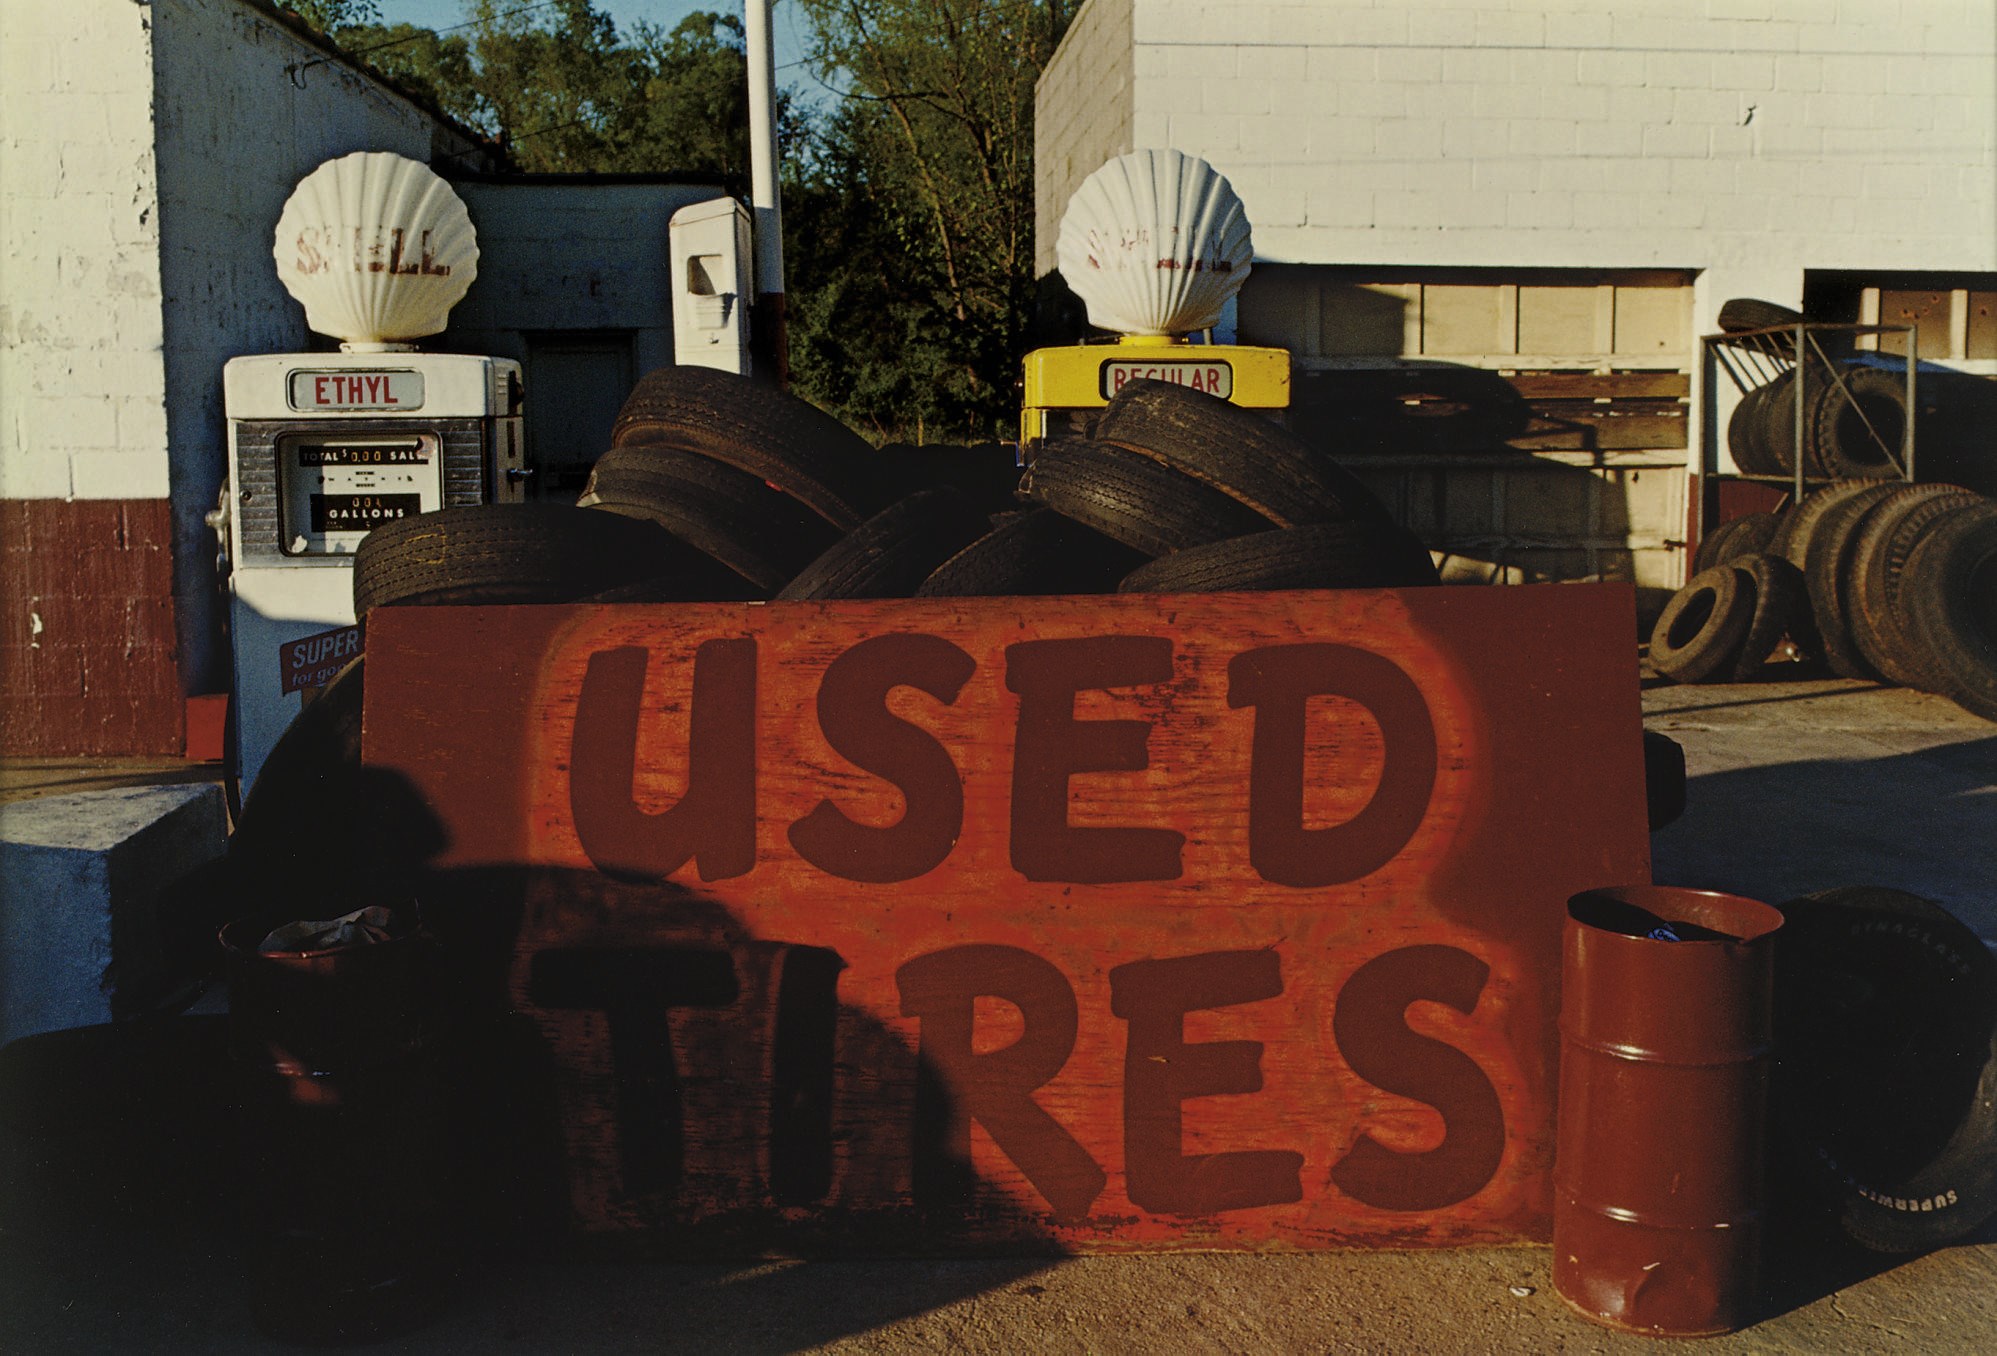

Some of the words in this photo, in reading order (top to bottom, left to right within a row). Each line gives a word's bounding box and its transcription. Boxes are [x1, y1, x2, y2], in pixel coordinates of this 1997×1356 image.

[296, 226, 450, 276] SELL
[315, 376, 398, 404] ETHYL
[302, 451, 339, 462] TOTAL
[389, 451, 425, 461] SAL
[329, 508, 405, 519] GALLONS
[292, 629, 359, 669] SUPER
[570, 633, 1438, 888] USED
[530, 941, 1506, 1225] TIRES
